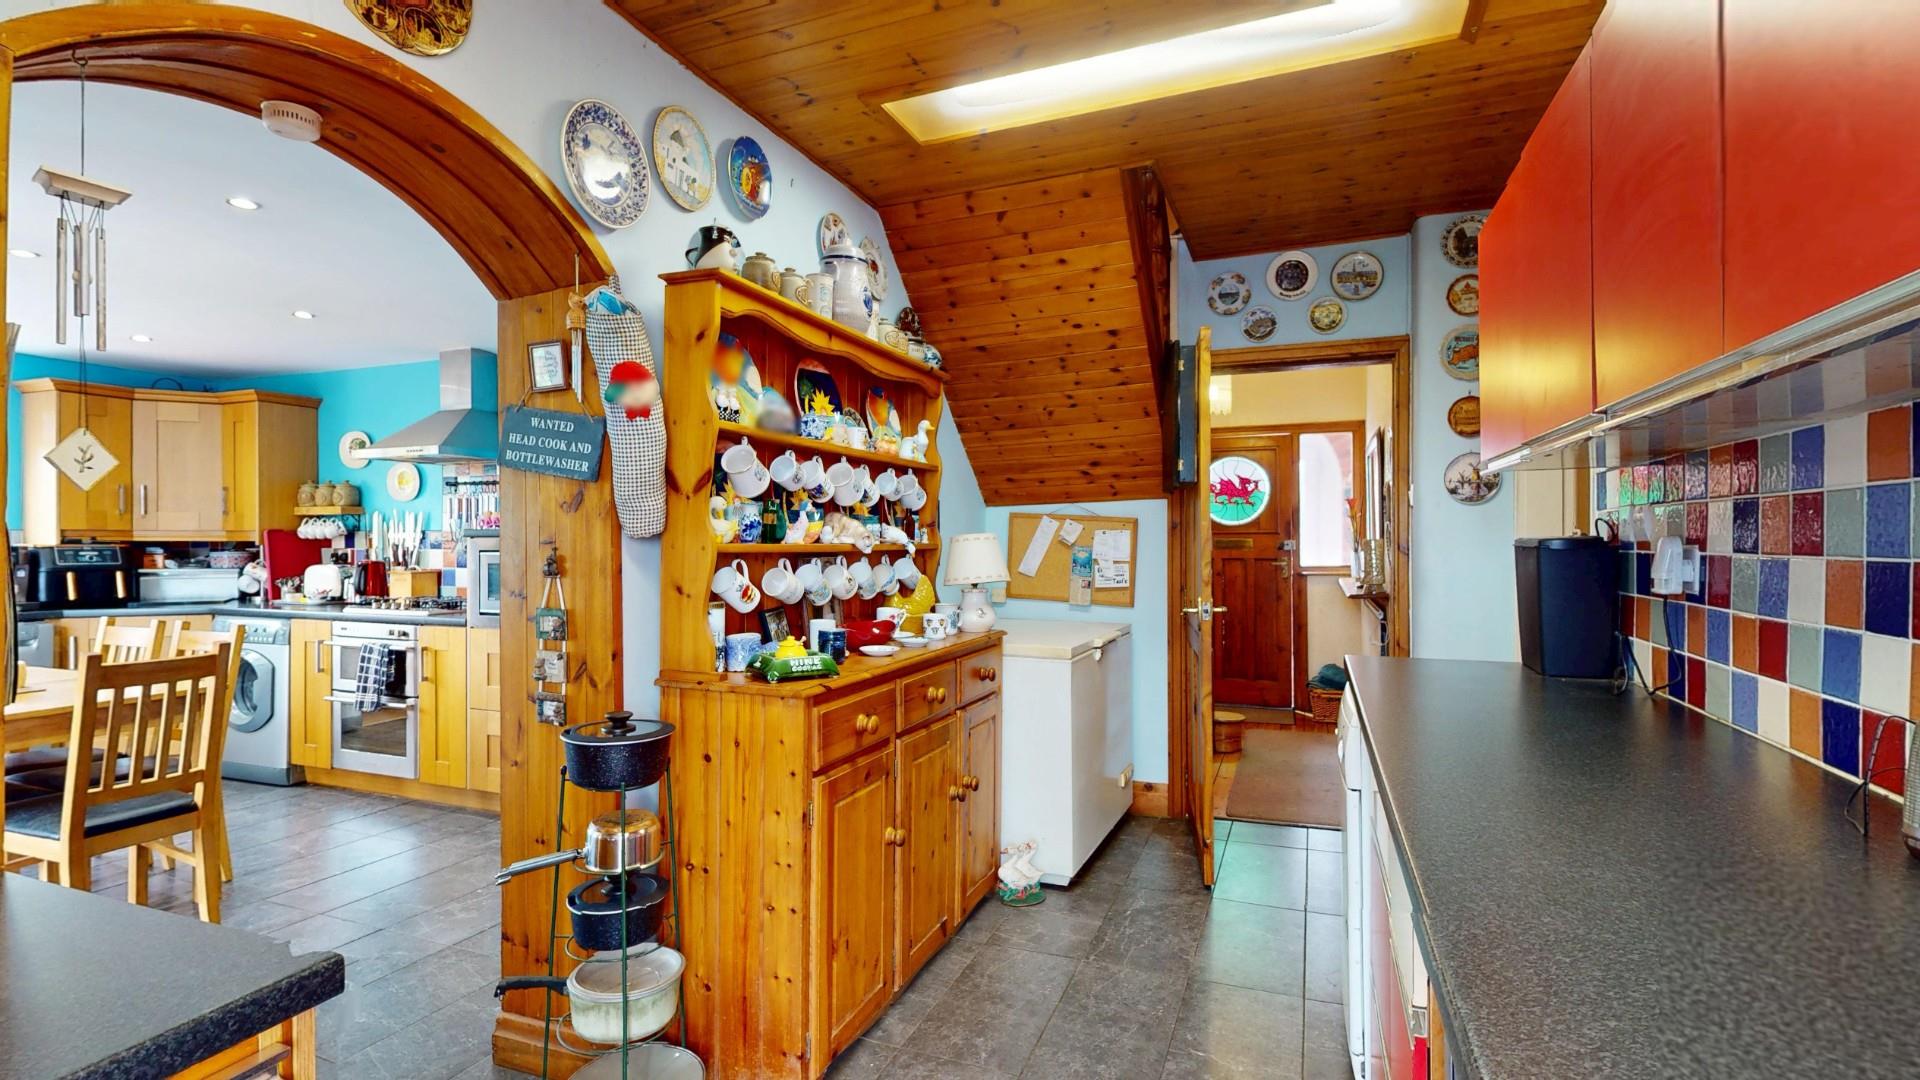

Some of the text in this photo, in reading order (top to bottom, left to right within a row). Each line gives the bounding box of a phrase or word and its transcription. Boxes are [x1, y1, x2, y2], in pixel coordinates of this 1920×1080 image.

[531, 417, 574, 432] WANTED
[508, 433, 592, 454] HEAD COOK AND
[505, 450, 589, 472] BOTTLEWASHER
[790, 657, 821, 666] HINE
